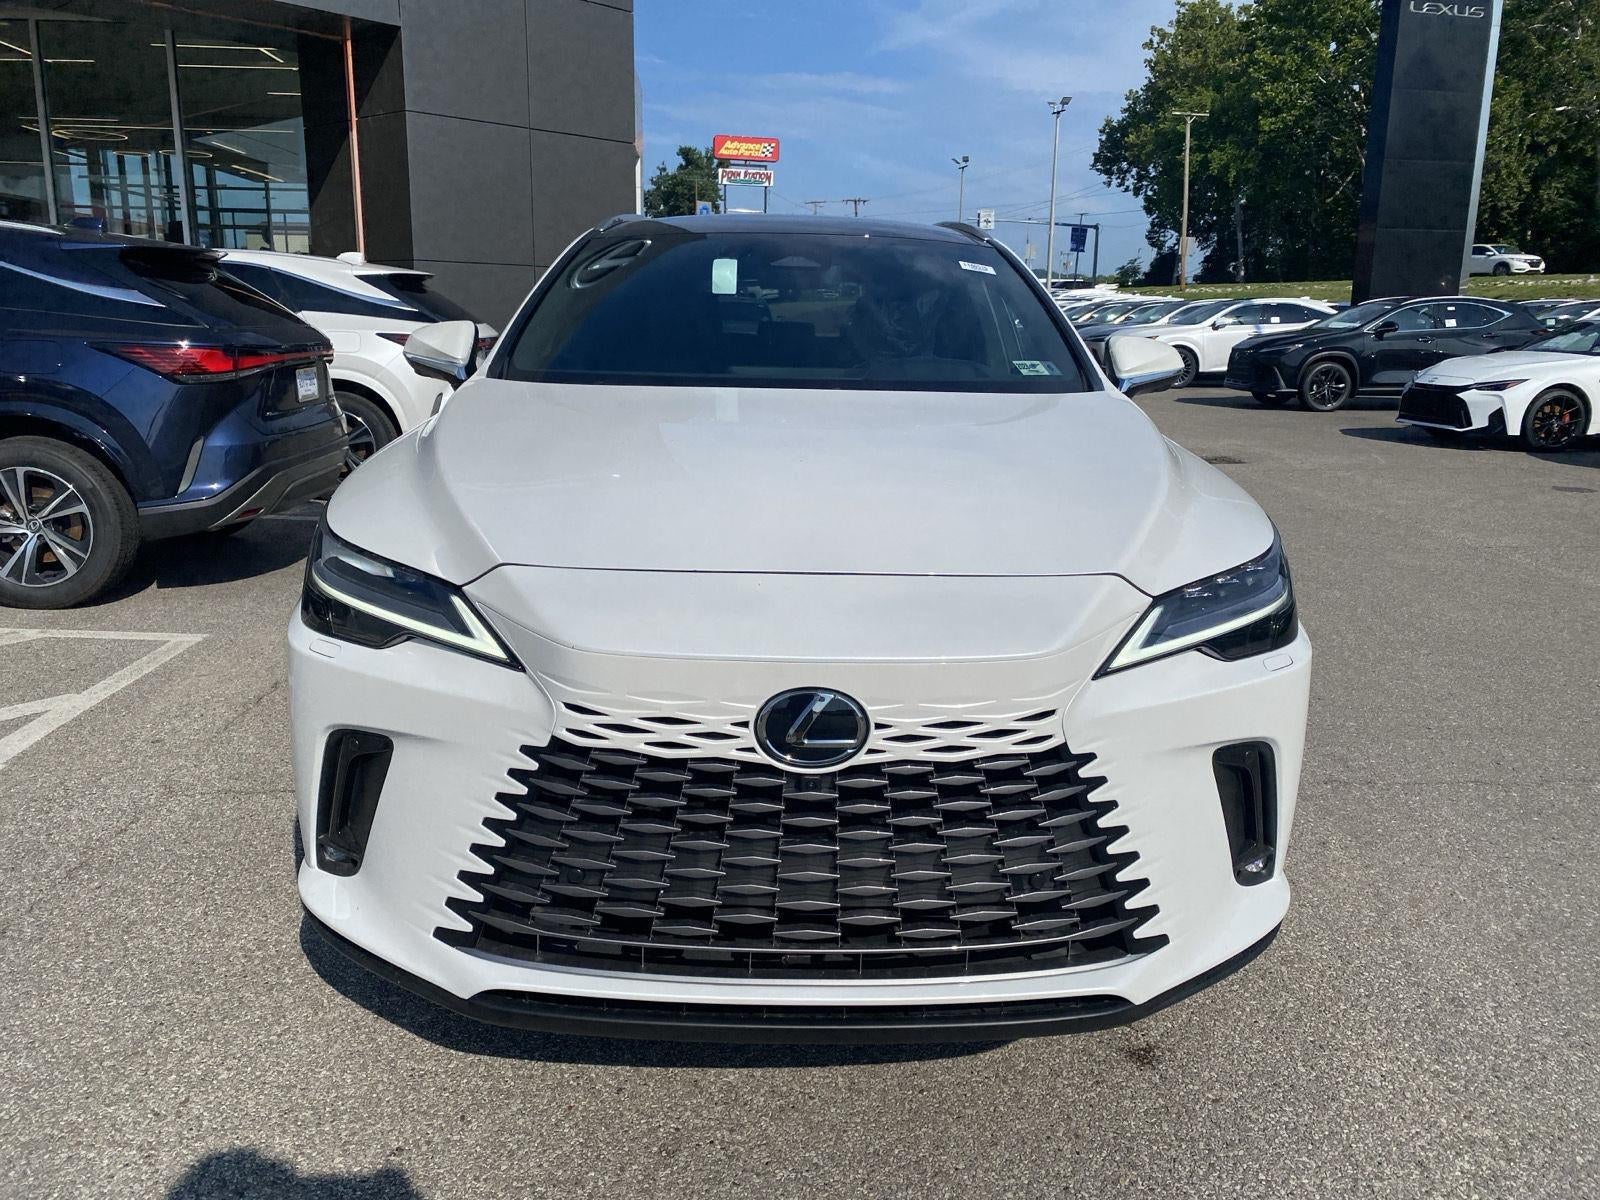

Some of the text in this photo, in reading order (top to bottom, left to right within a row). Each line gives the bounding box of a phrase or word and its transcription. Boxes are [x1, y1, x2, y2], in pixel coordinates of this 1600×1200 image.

[1409, 1, 1485, 18] LEXUS
[722, 140, 761, 150] Advance
[743, 170, 772, 186] STATION
